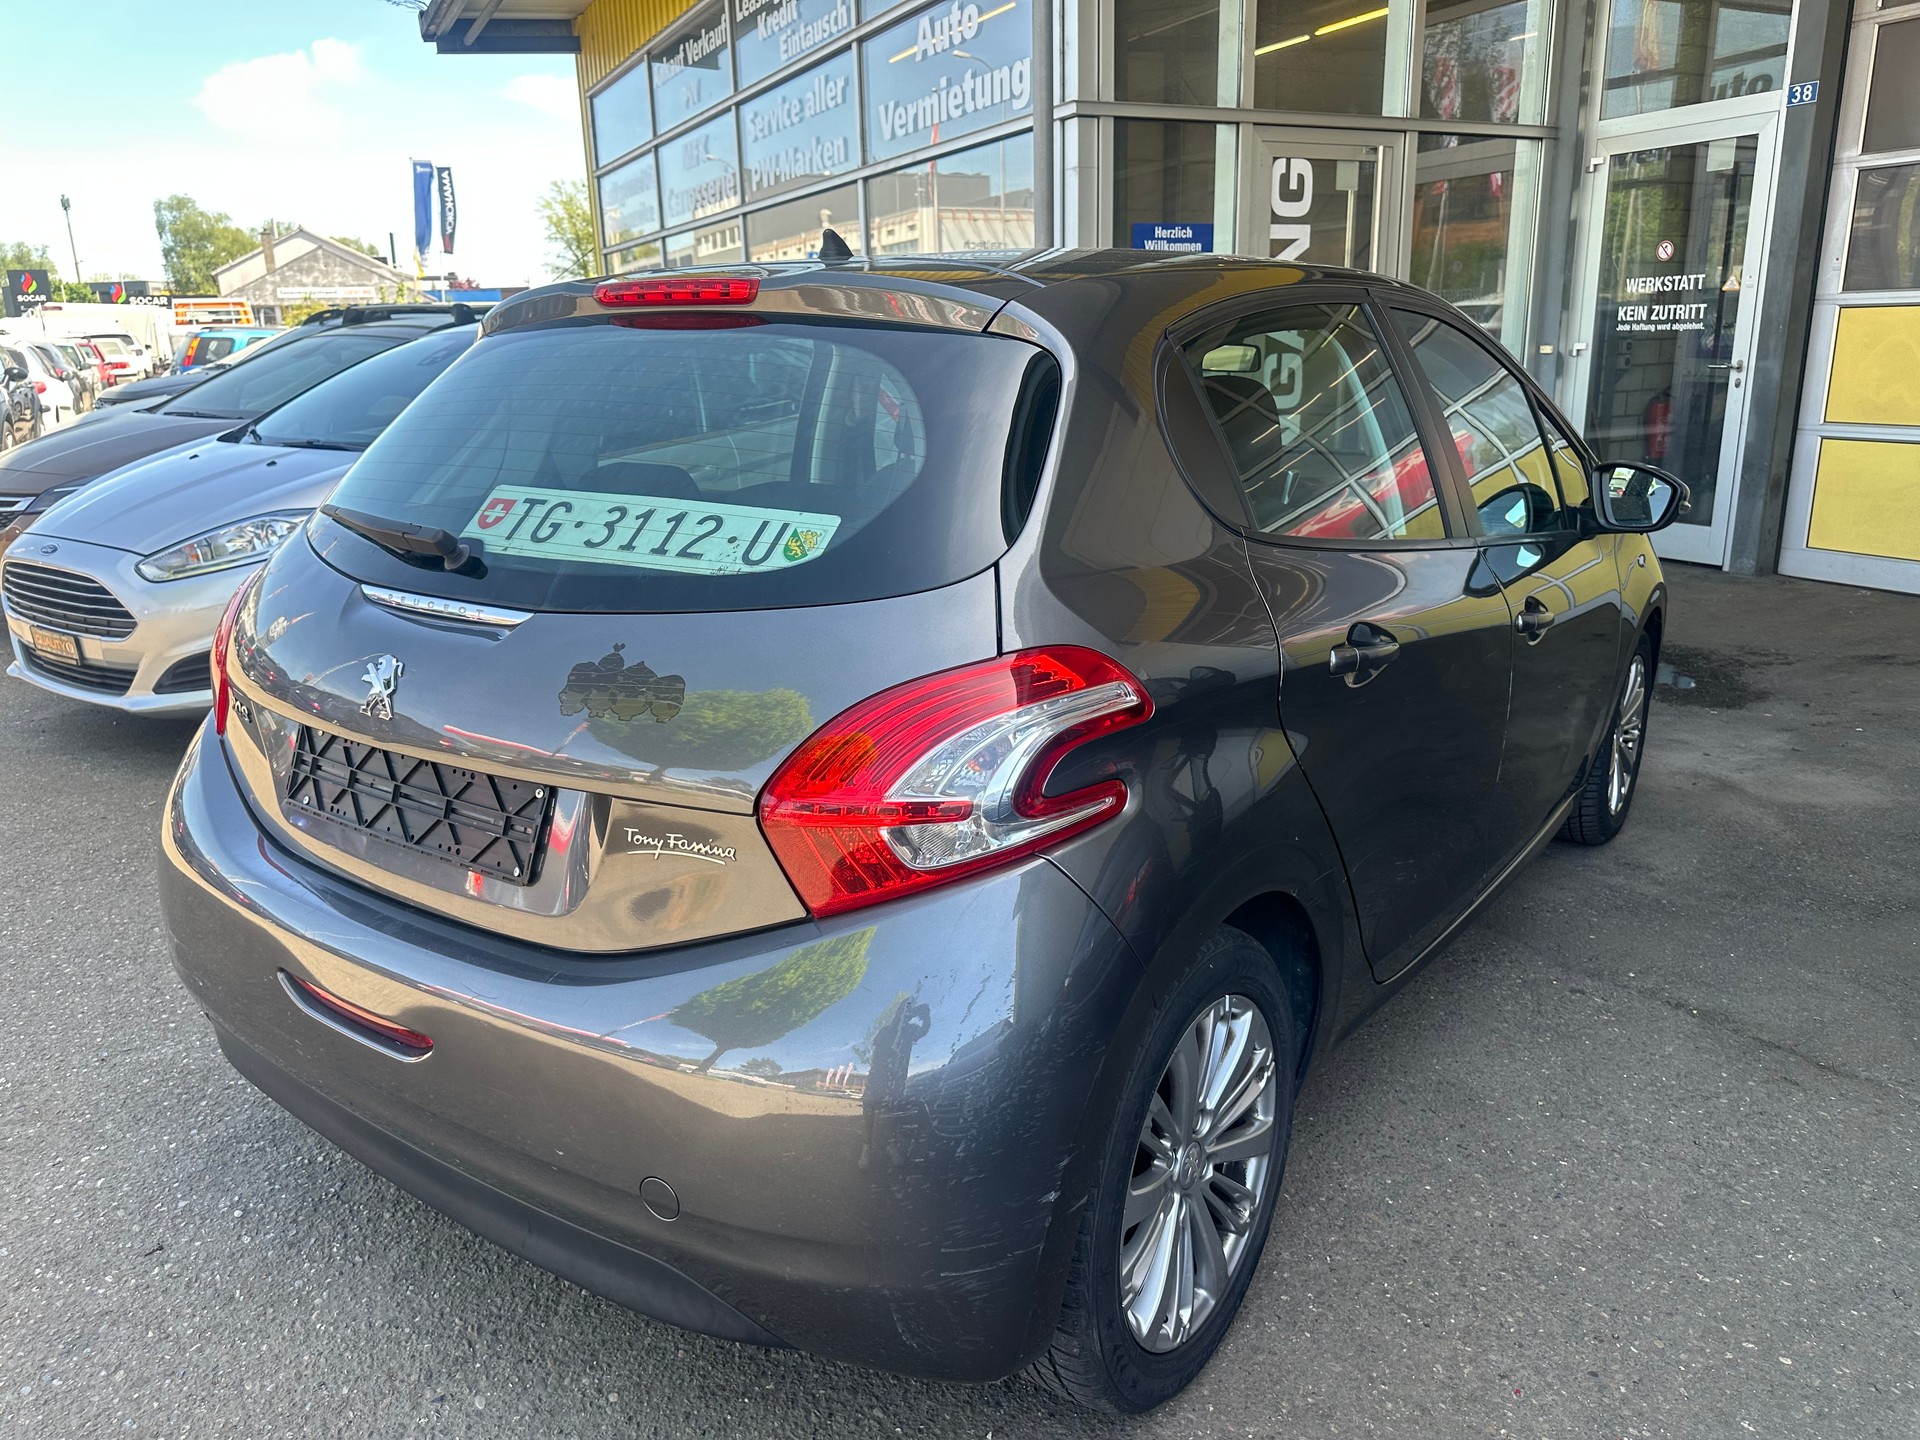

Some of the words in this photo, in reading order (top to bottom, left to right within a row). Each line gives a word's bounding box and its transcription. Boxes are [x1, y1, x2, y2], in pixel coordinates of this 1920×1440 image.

[757, 0, 798, 41] Kredit
[780, 0, 848, 62] Eintausch
[915, 0, 979, 62] Auto
[685, 13, 727, 66] Verkauf
[747, 94, 802, 143] Service
[804, 74, 845, 118] aller
[878, 57, 1031, 141] Vermietung
[1791, 84, 1813, 104] 38
[751, 136, 846, 192] PW-Marken
[441, 170, 455, 235] YOKOHAMA
[1144, 239, 1202, 251] Willkommen
[1154, 226, 1193, 239] Herzlich
[17, 294, 47, 303] SOCAR
[1626, 274, 1706, 293] WERKSTATT
[129, 296, 169, 306] SOCAR
[1617, 305, 1648, 321] KEIN
[1650, 304, 1708, 320] ZUTRITT
[1616, 323, 1631, 331] Jede
[1631, 323, 1656, 332] Haftung
[1656, 323, 1671, 331] wird
[1671, 321, 1705, 332] abgelehnt.
[388, 593, 484, 619] PEUGEOT
[623, 827, 664, 860] Tony
[665, 833, 737, 861] Fassina
